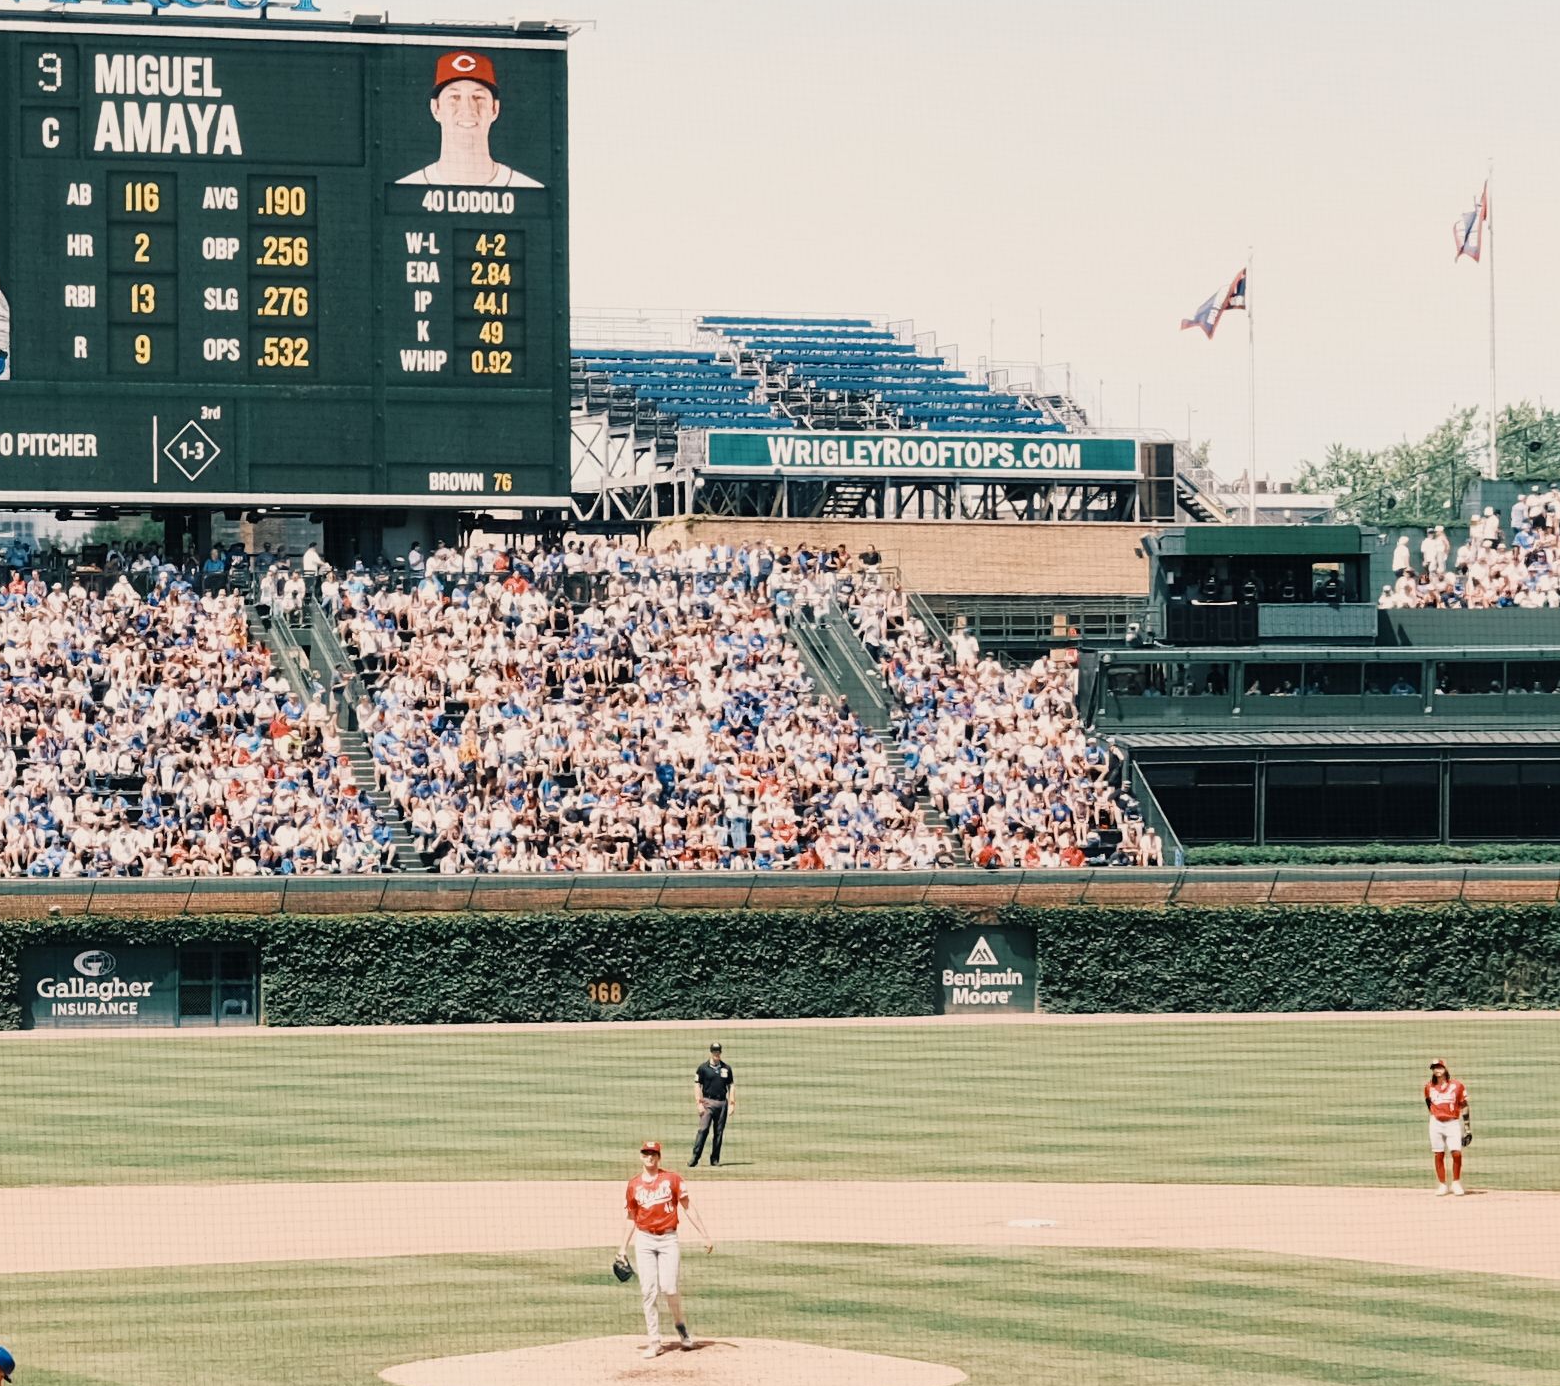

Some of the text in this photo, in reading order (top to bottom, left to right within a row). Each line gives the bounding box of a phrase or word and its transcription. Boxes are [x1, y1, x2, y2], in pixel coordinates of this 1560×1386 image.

[39, 53, 221, 97] 9 MIGUEL
[42, 101, 242, 155] C AMAYA
[67, 183, 305, 215] AB 116 AVG .190
[422, 190, 514, 213] 40 LODOLO
[68, 234, 308, 266] HR 2 OBP .256
[406, 233, 505, 256] W-L 4-2
[407, 262, 510, 285] ERA 2.84
[65, 284, 308, 316] RBI 13 SLG .276
[415, 290, 507, 314] IP 44.1
[418, 321, 503, 344] K 49
[75, 335, 308, 366] R 9 OPS .532
[400, 350, 511, 373] WHIP 0.92
[201, 406, 220, 419] 3rd
[18, 433, 97, 456] PITCHER
[180, 442, 205, 459] 1-3
[766, 436, 1081, 469] WRIGLEYROOFTOPS.COM
[429, 472, 512, 491] BROWN 76
[36, 977, 153, 1001] Gallagher
[942, 968, 1023, 990] Benjamin
[587, 982, 622, 1003] 368
[952, 987, 1013, 1004] Moore
[51, 1002, 138, 1016] INSURANCE
